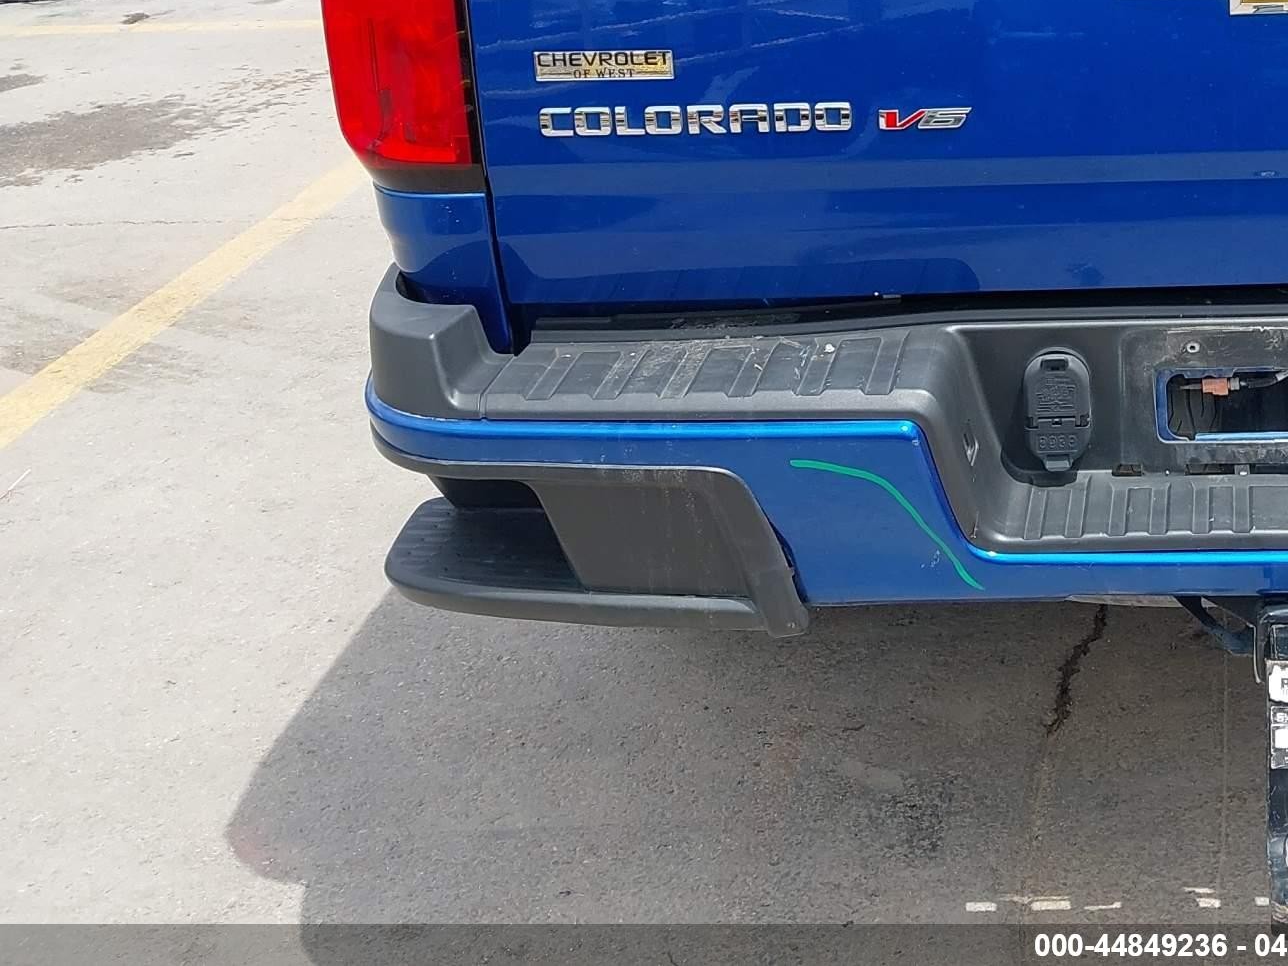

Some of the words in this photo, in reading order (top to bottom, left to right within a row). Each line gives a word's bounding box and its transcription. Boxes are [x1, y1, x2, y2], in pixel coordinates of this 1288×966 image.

[537, 50, 671, 68] CHEVROLET
[573, 69, 591, 80] OF
[595, 68, 636, 79] WEST
[539, 101, 852, 137] COLORADO
[878, 107, 972, 131] V6
